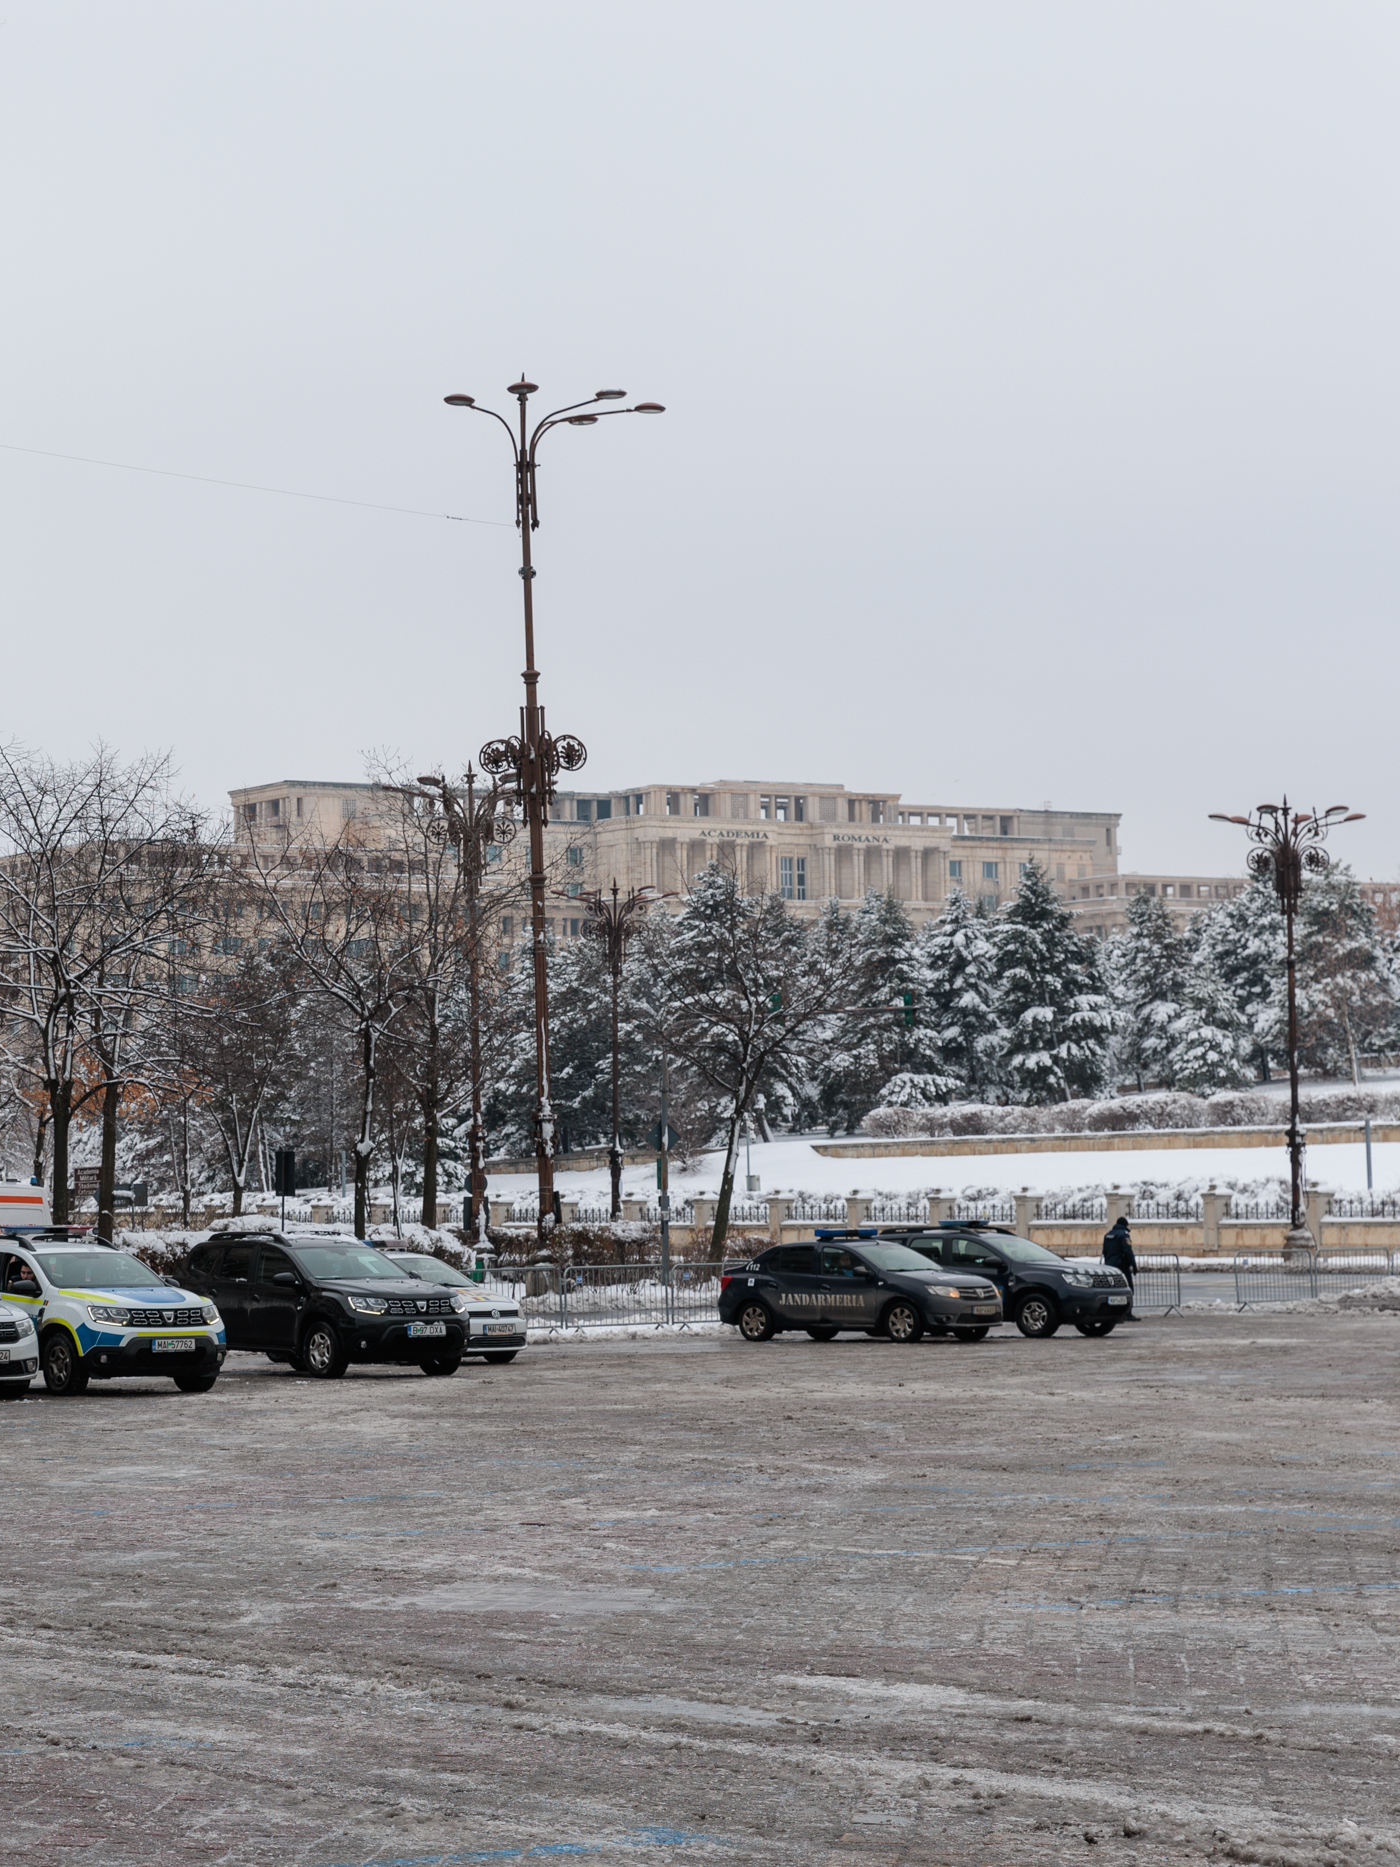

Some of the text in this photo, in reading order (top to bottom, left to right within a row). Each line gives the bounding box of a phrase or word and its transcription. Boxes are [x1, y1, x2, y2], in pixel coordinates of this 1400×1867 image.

[699, 830, 769, 840] ACADEMIA
[779, 1294, 865, 1307] JANDARMERIA
[430, 1326, 443, 1334] DXA
[157, 1340, 193, 1349] MAI 57762
